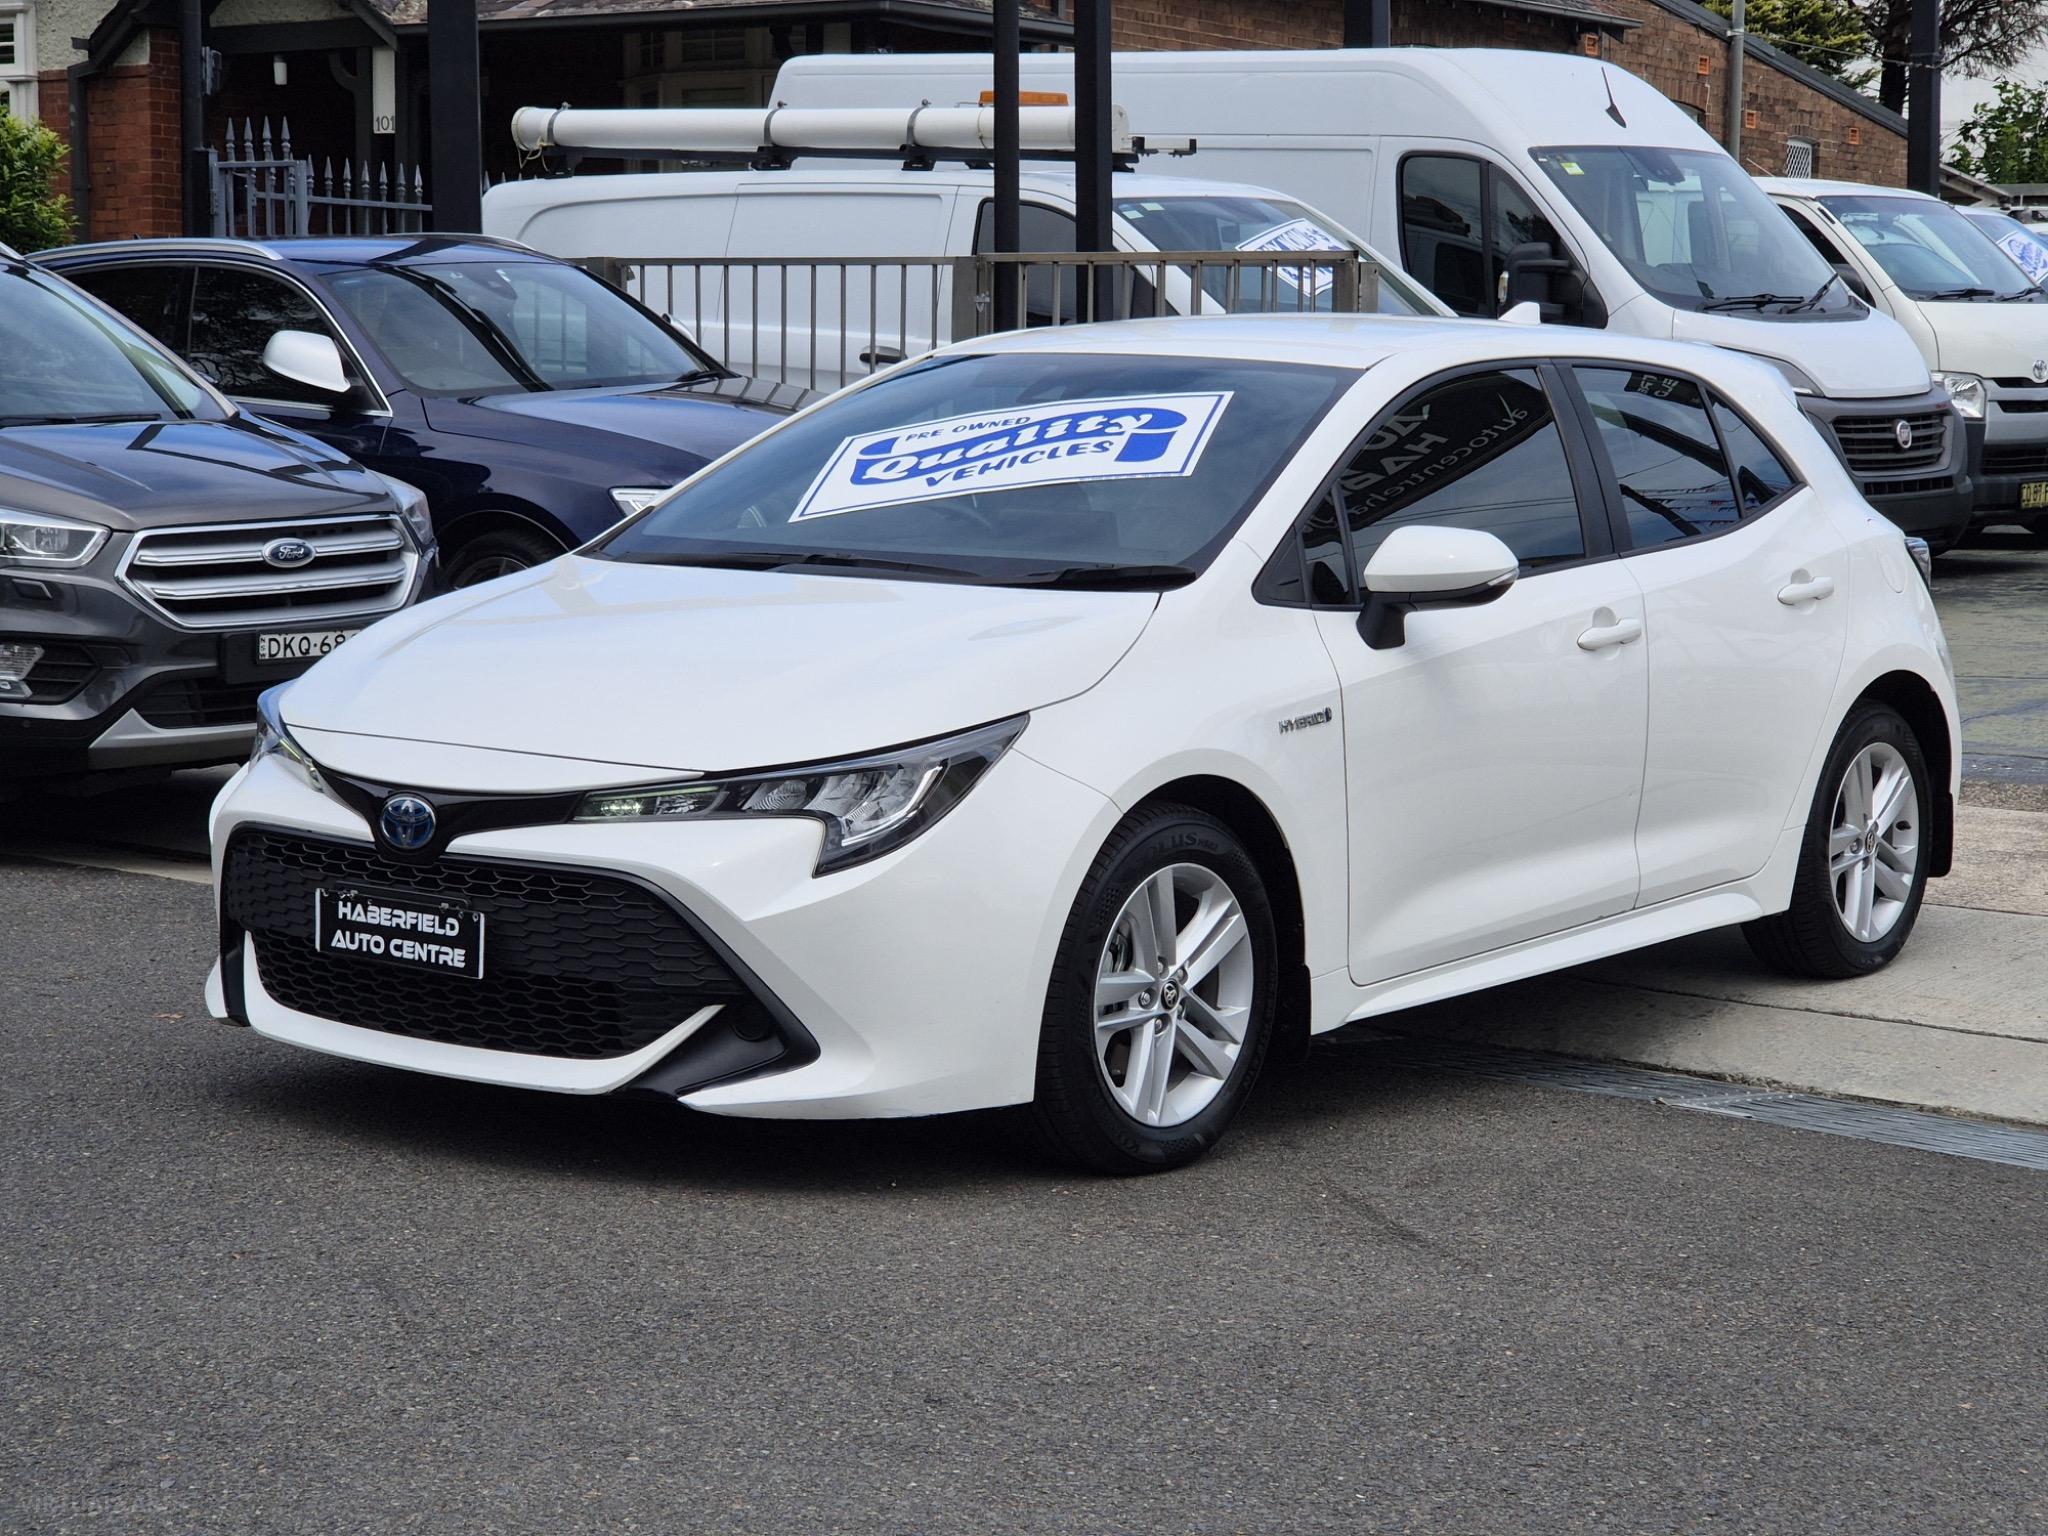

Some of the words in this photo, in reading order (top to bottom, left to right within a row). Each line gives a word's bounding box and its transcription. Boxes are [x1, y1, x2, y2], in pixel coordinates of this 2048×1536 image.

[375, 115, 395, 132] 101
[861, 412, 1154, 481] Quality
[905, 428, 945, 442] PRE
[951, 416, 1031, 433] OWNED
[925, 440, 1114, 487] VEHICLES
[278, 545, 305, 560] Ford
[337, 900, 460, 937] HABERFIELD
[330, 929, 386, 955] AUTO
[388, 938, 467, 969] CENTRE
